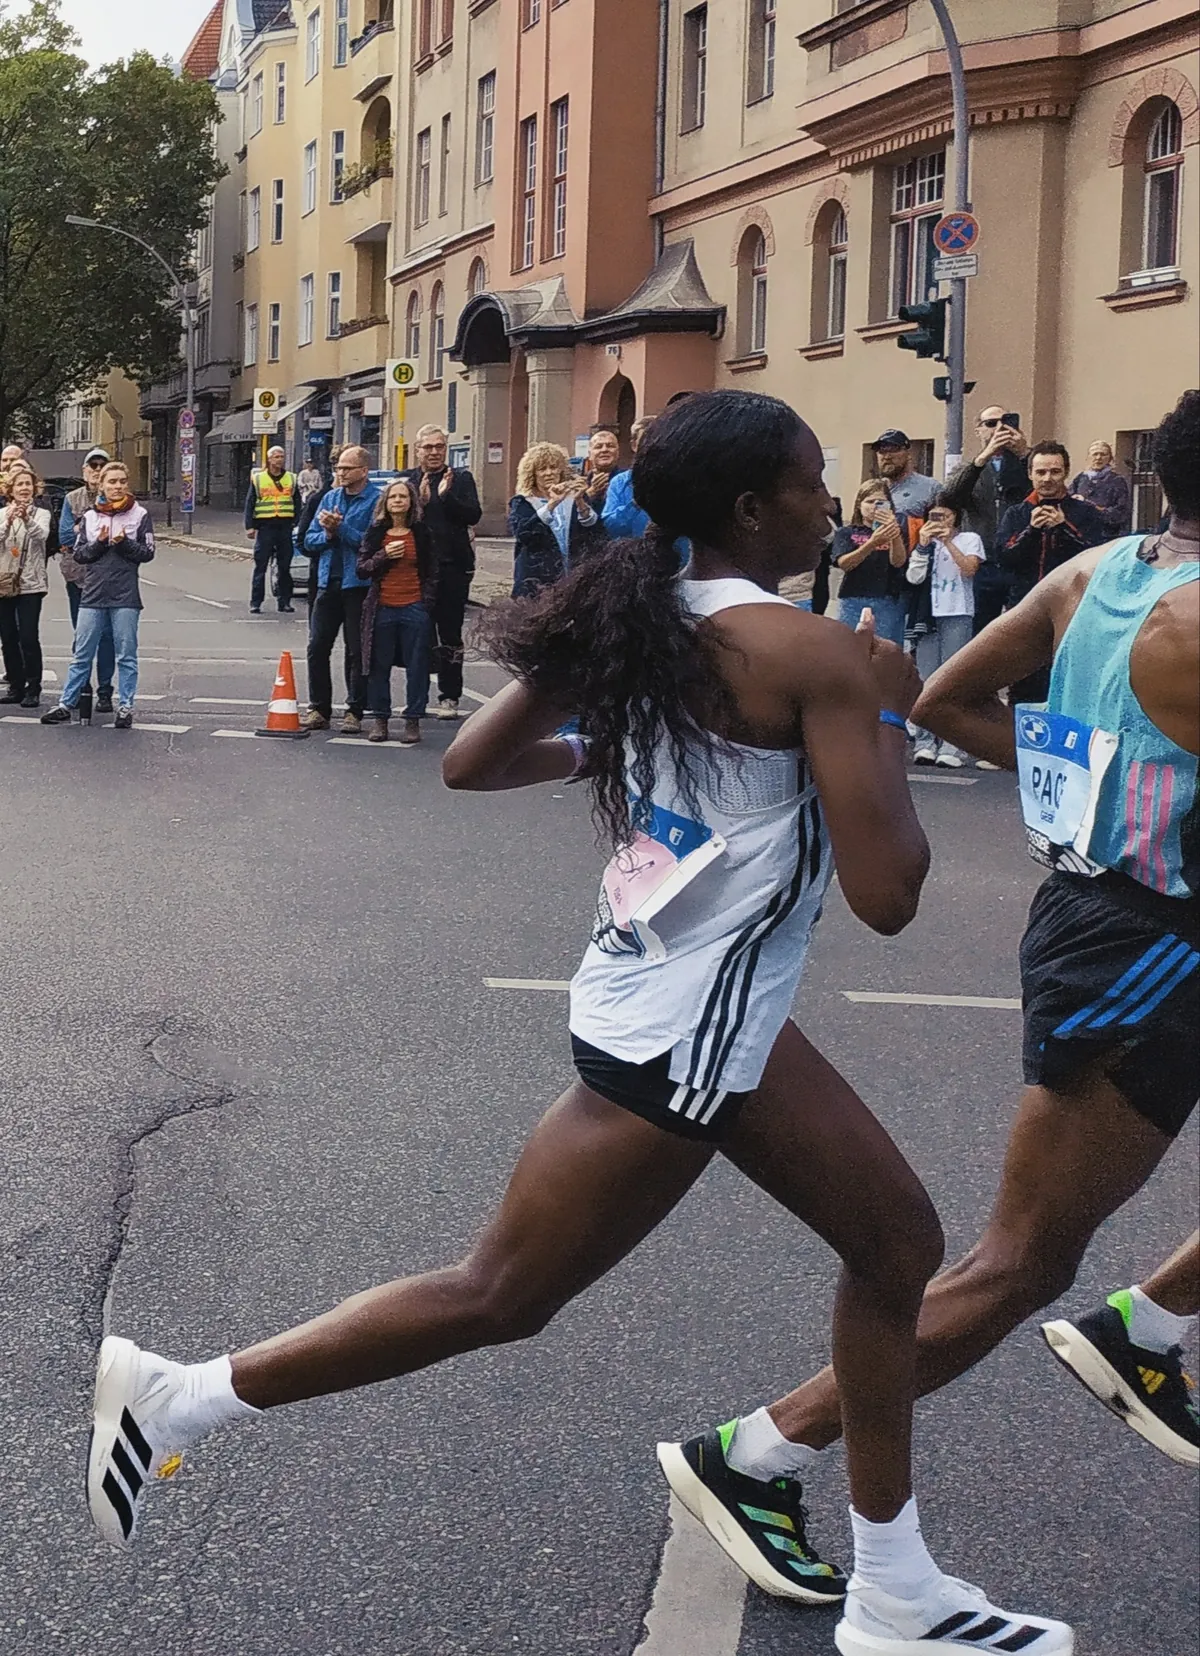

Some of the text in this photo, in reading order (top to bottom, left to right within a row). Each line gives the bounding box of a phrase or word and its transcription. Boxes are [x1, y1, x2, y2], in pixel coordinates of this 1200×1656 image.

[607, 346, 618, 355] 76
[398, 368, 409, 379] H
[262, 394, 271, 404] H
